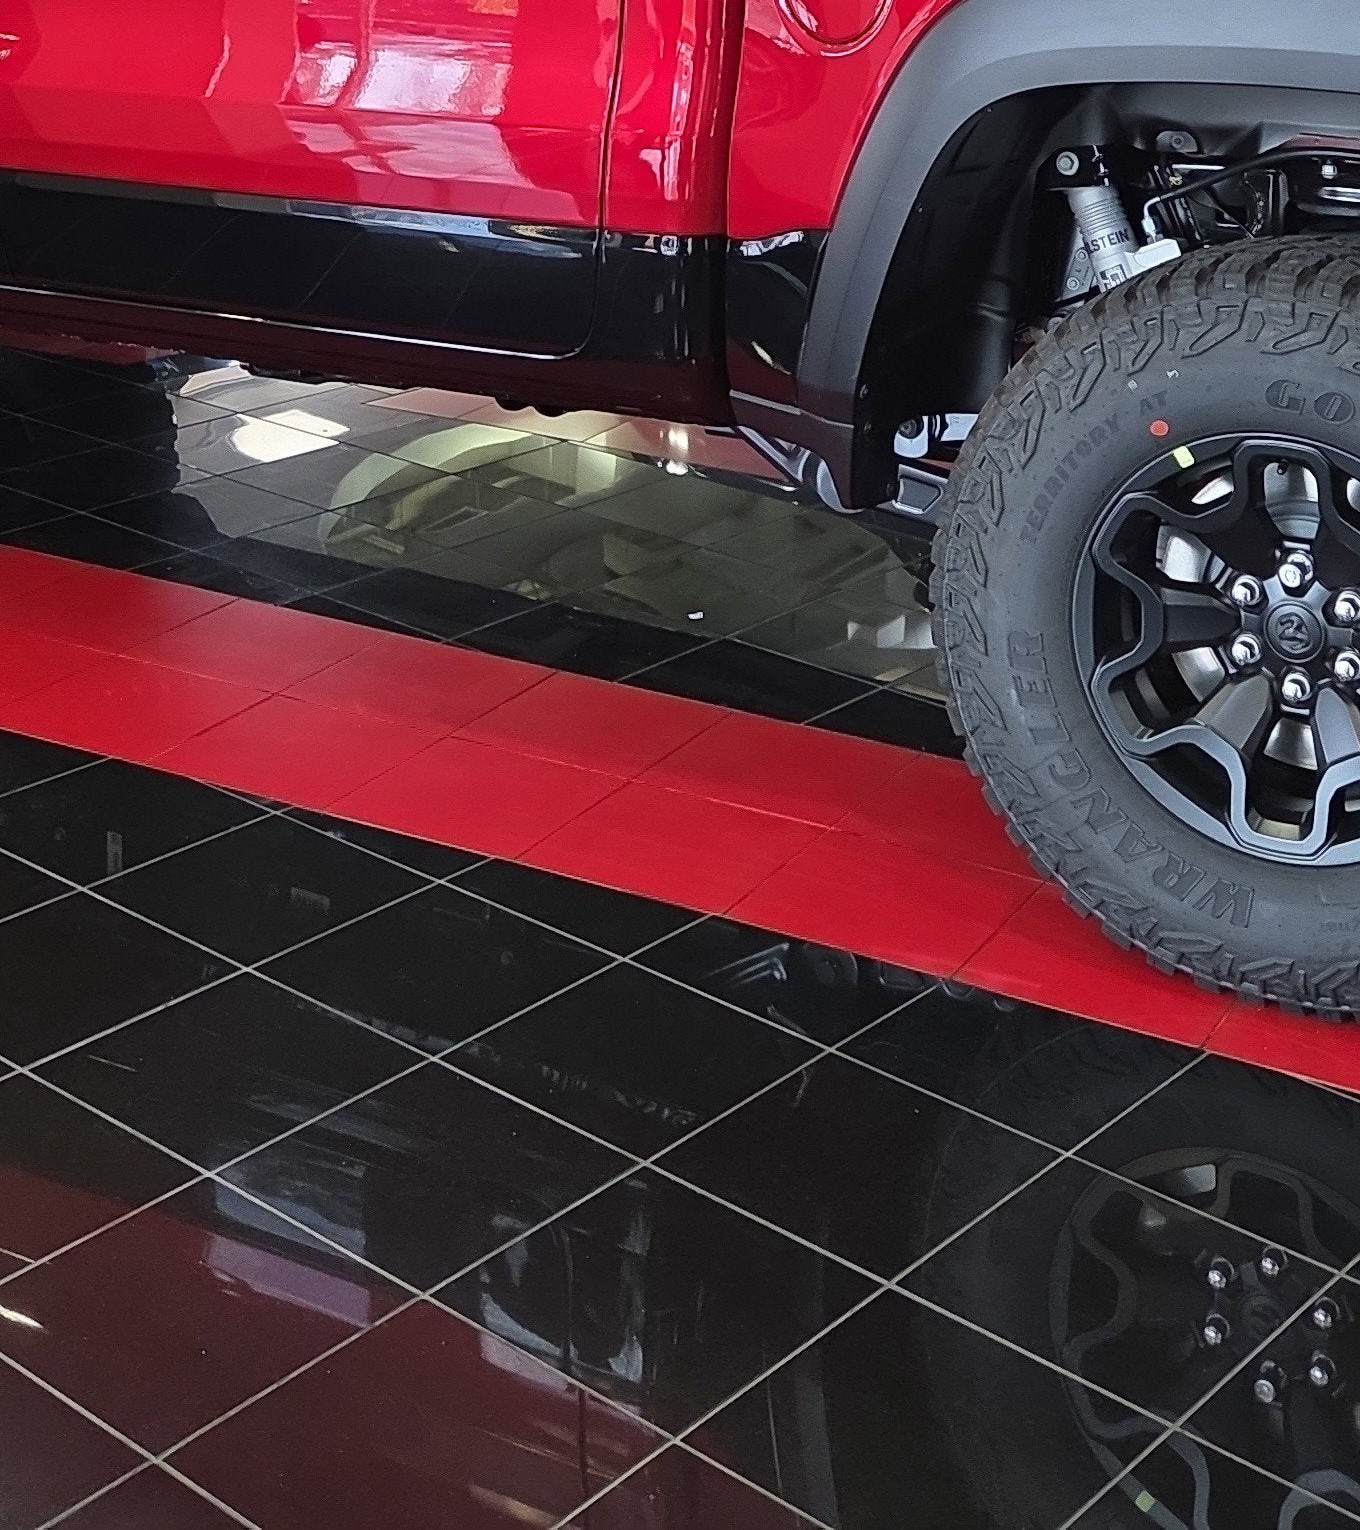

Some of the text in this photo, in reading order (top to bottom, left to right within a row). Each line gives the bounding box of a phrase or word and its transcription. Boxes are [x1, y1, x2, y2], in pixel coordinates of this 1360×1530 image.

[1019, 389, 1168, 543] TERRITORY AT
[1007, 631, 1255, 929] WRANGLER
